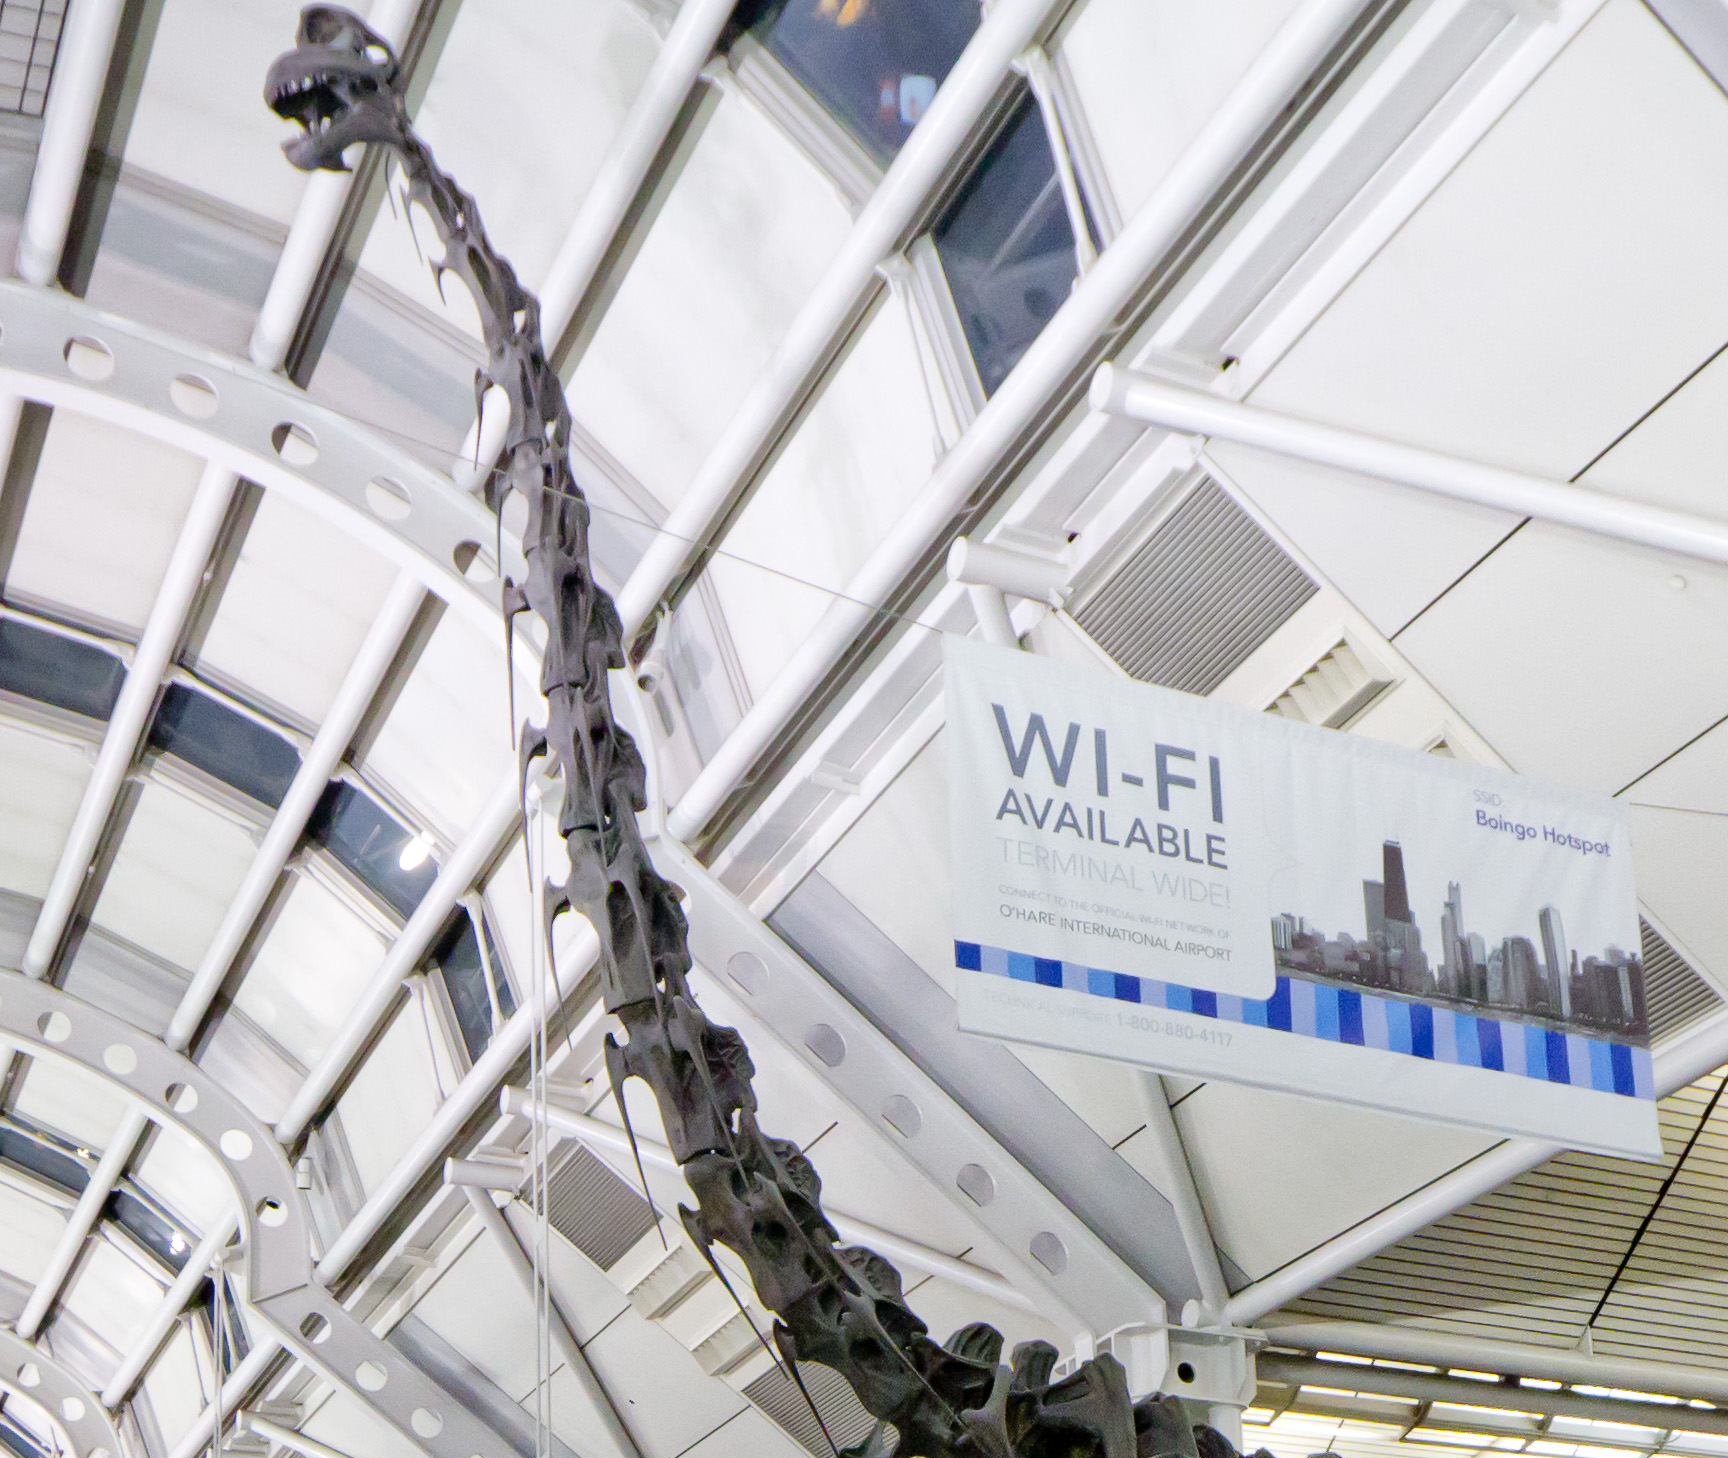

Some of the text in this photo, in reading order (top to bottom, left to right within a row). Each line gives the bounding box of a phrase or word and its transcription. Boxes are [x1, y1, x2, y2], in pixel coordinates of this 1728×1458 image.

[990, 702, 1224, 824] WI-FI
[995, 787, 1229, 870] AVAILABLE
[1476, 809, 1611, 857] Boingo Hotspot
[995, 836, 1231, 910] TERMINAL WIDE!
[998, 884, 1052, 903] CONNECT
[1054, 895, 1069, 909] TO
[1071, 898, 1091, 912] THE
[1091, 902, 1138, 922] OFFICIAL
[1165, 918, 1216, 937] NETWORK
[999, 903, 1233, 962] O'HARE INTERNATIONAL AIRPORT
[1116, 1011, 1233, 1047] 1-800-880-4117
